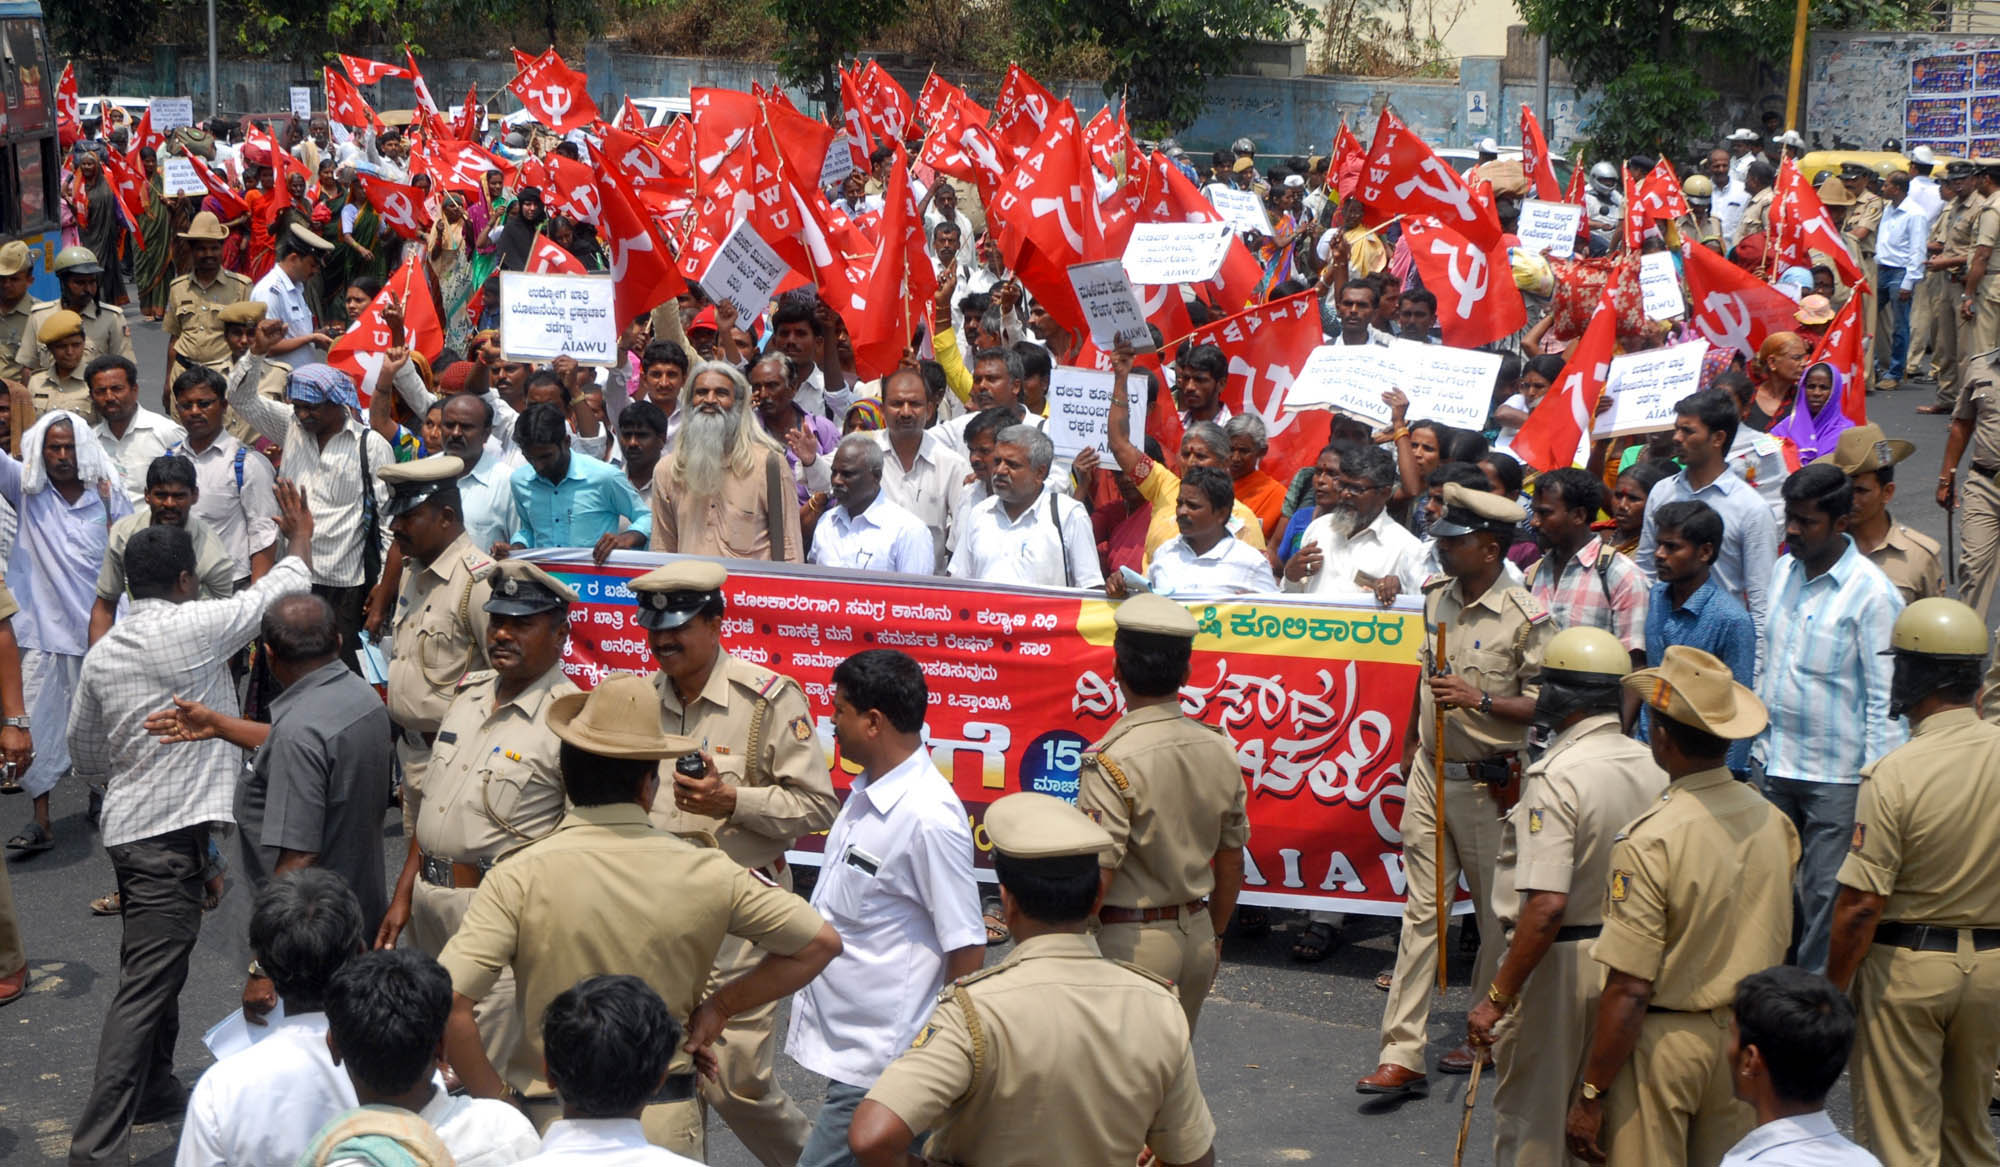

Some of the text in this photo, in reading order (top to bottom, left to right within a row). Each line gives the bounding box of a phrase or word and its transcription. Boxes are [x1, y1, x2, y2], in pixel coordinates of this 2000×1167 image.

[748, 127, 790, 230] IAWU
[1000, 116, 1075, 211] AIAWU
[703, 165, 744, 216] AWU
[1630, 176, 1645, 243] IAWU
[370, 281, 394, 347] AWU
[560, 340, 608, 354] AIAWU
[1056, 384, 1139, 405] ದಲಿತ ಕೂಲಿರ
[1339, 393, 1388, 416] AIAWU
[1432, 402, 1479, 418] AIAWU
[1645, 407, 1677, 420] AIAW
[593, 610, 625, 631] ಖಾತ್ರಿ
[720, 618, 756, 638] ಸ್ತರಣೆ
[777, 623, 821, 647] ವಾಸಕ್ಕೆ
[825, 626, 853, 642] ಮನೆ
[944, 633, 994, 653] ರೇಷನ್
[1019, 641, 1051, 656] ಸಾಲ
[845, 598, 886, 622] ಸಮಗ್ರ
[891, 603, 952, 622] ಕಾನೂನು
[976, 608, 1027, 635] ಕಲ್ಯಾಣ
[1031, 613, 1058, 631] ನಿಧಿ
[1230, 608, 1405, 646] ಕೂಲಿಕಾರರ
[600, 637, 652, 664] ಅನಧಿಕೃ
[947, 692, 1012, 714] ಒತ್ತಾಯಿಸಿ
[1043, 739, 1082, 772] 15
